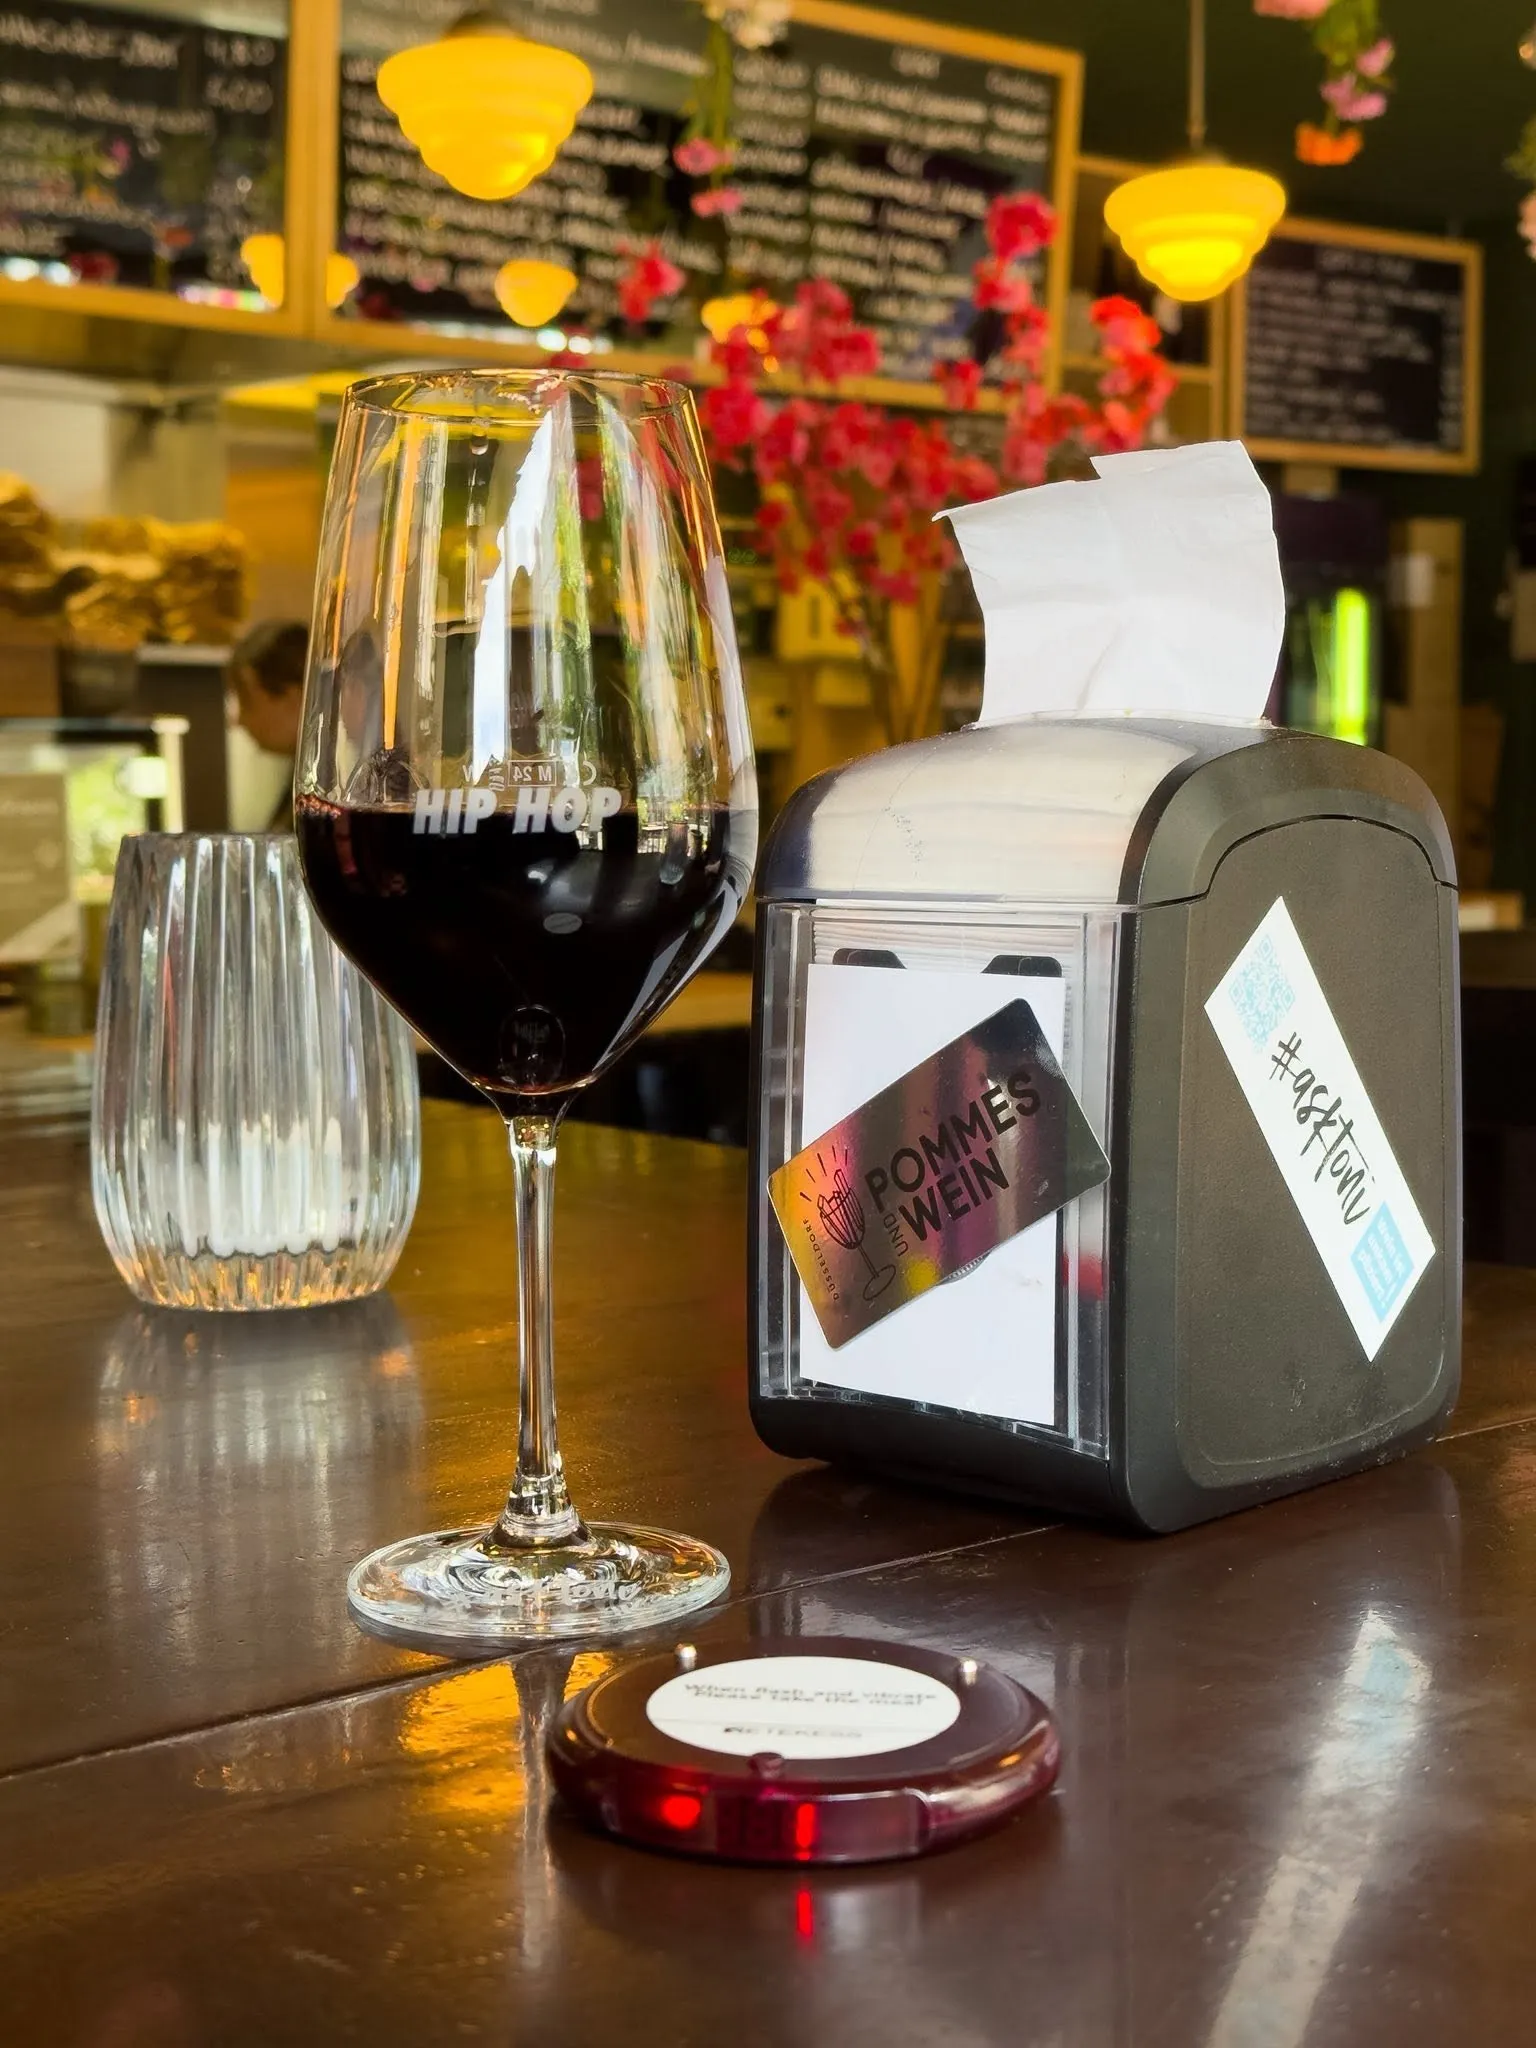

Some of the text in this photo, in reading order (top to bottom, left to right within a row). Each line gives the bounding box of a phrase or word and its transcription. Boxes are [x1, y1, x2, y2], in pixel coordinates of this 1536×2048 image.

[412, 785, 623, 835] HIP HOP
[865, 1070, 1041, 1213] POMMES
[898, 1147, 1010, 1242] WEIN
[883, 1212, 910, 1257] UND
